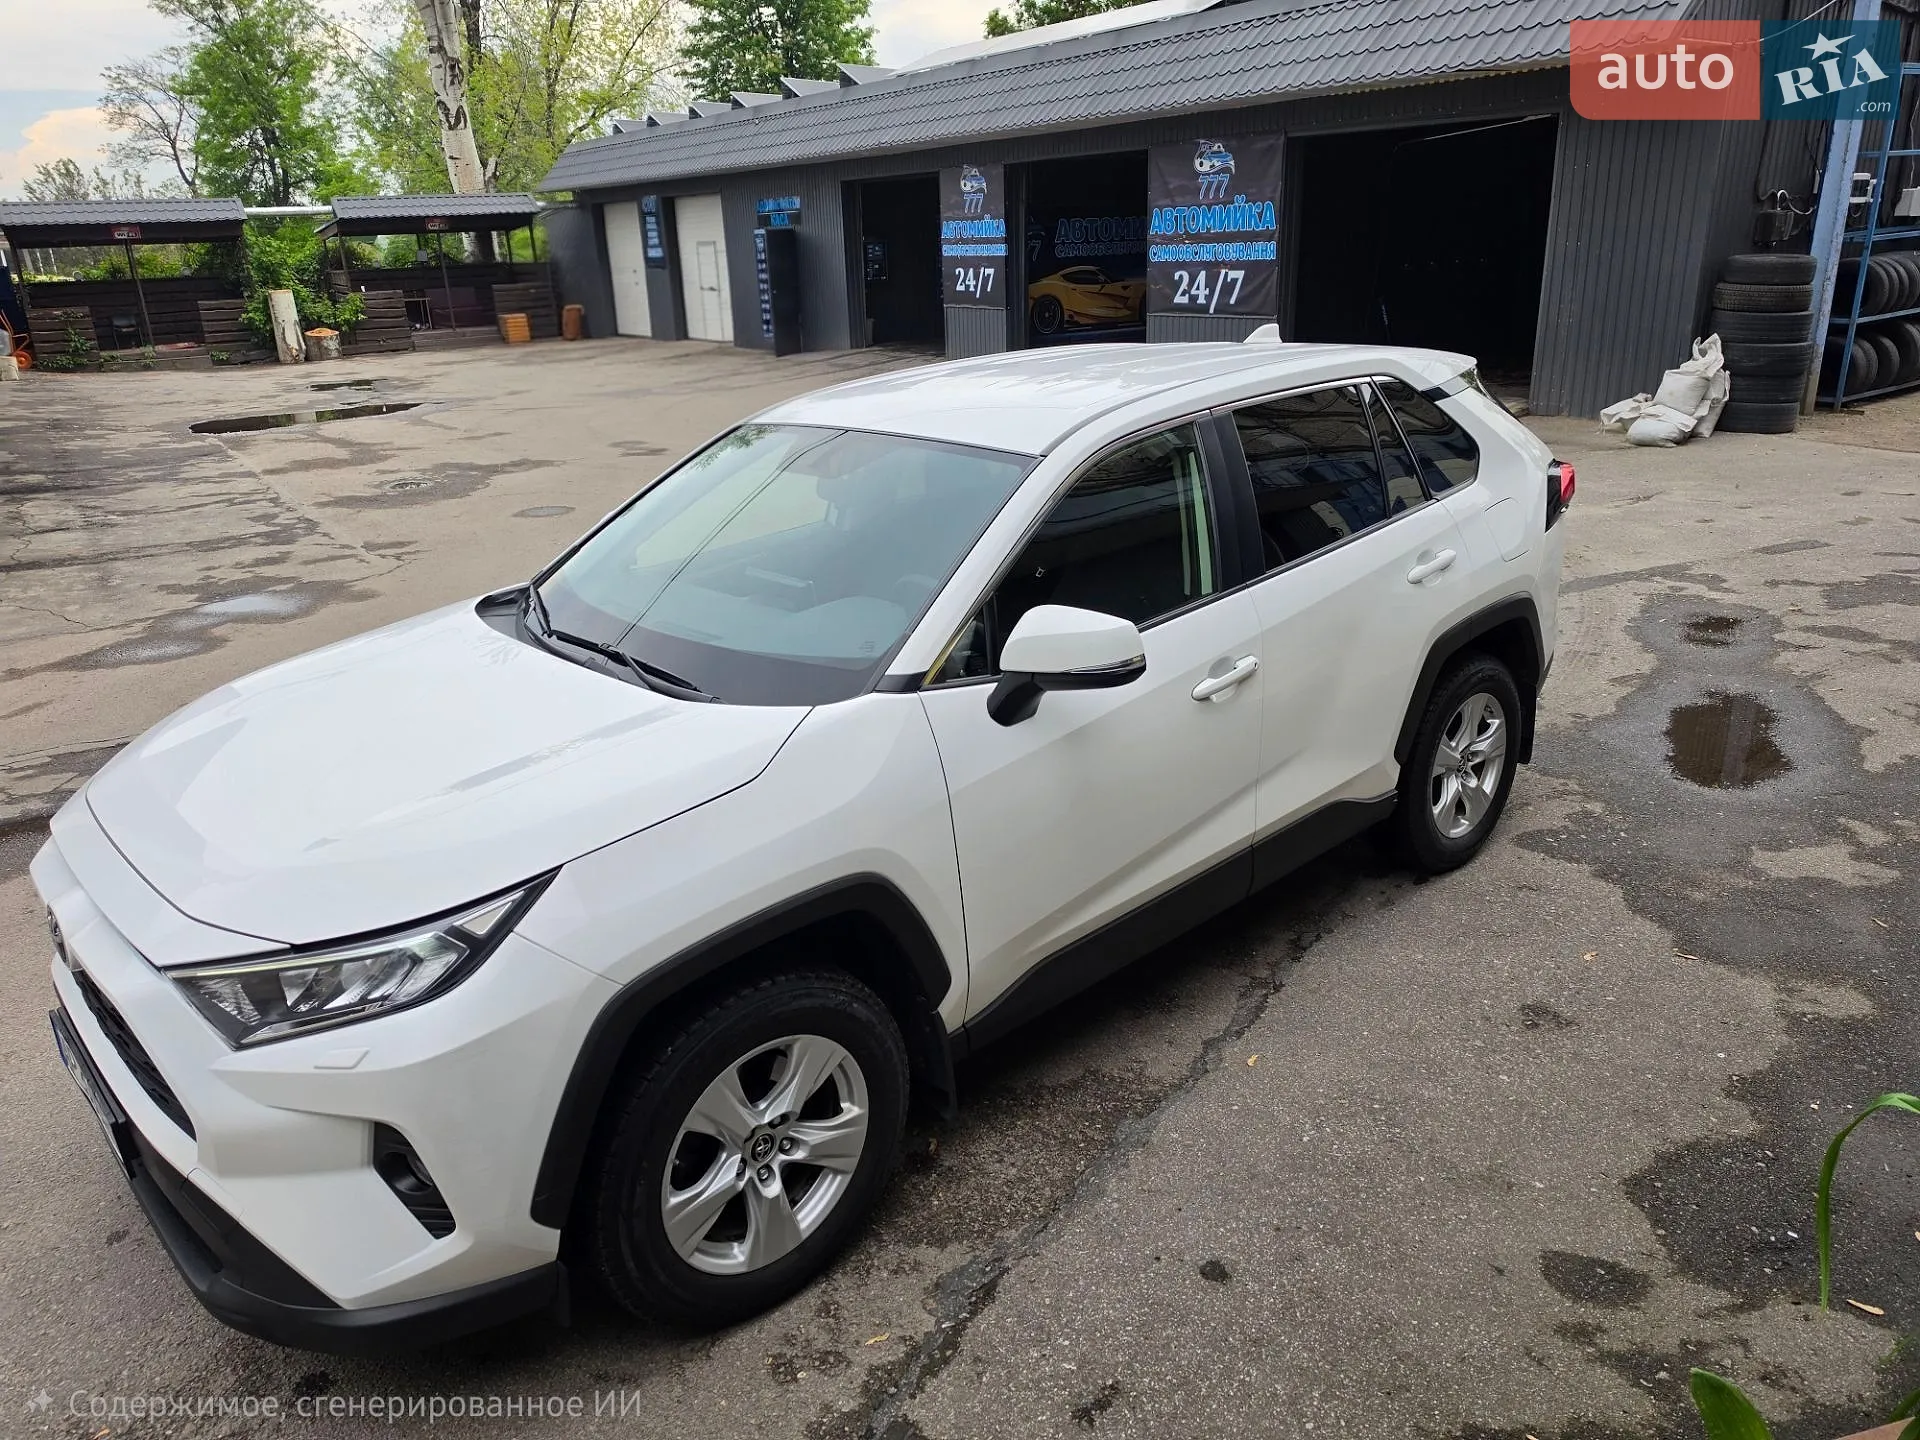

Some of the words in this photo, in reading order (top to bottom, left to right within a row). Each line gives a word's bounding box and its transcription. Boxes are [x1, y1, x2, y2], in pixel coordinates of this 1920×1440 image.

[1199, 173, 1230, 200] 777
[963, 193, 984, 214] 777
[1149, 194, 1276, 235] АВТОМИЙКА
[941, 213, 1006, 239] АВТОМИЙКА
[1149, 241, 1277, 262] САМООБСЛУГОВУВАННЯ
[955, 266, 995, 299] 24/7
[1173, 268, 1245, 314] 24/7
